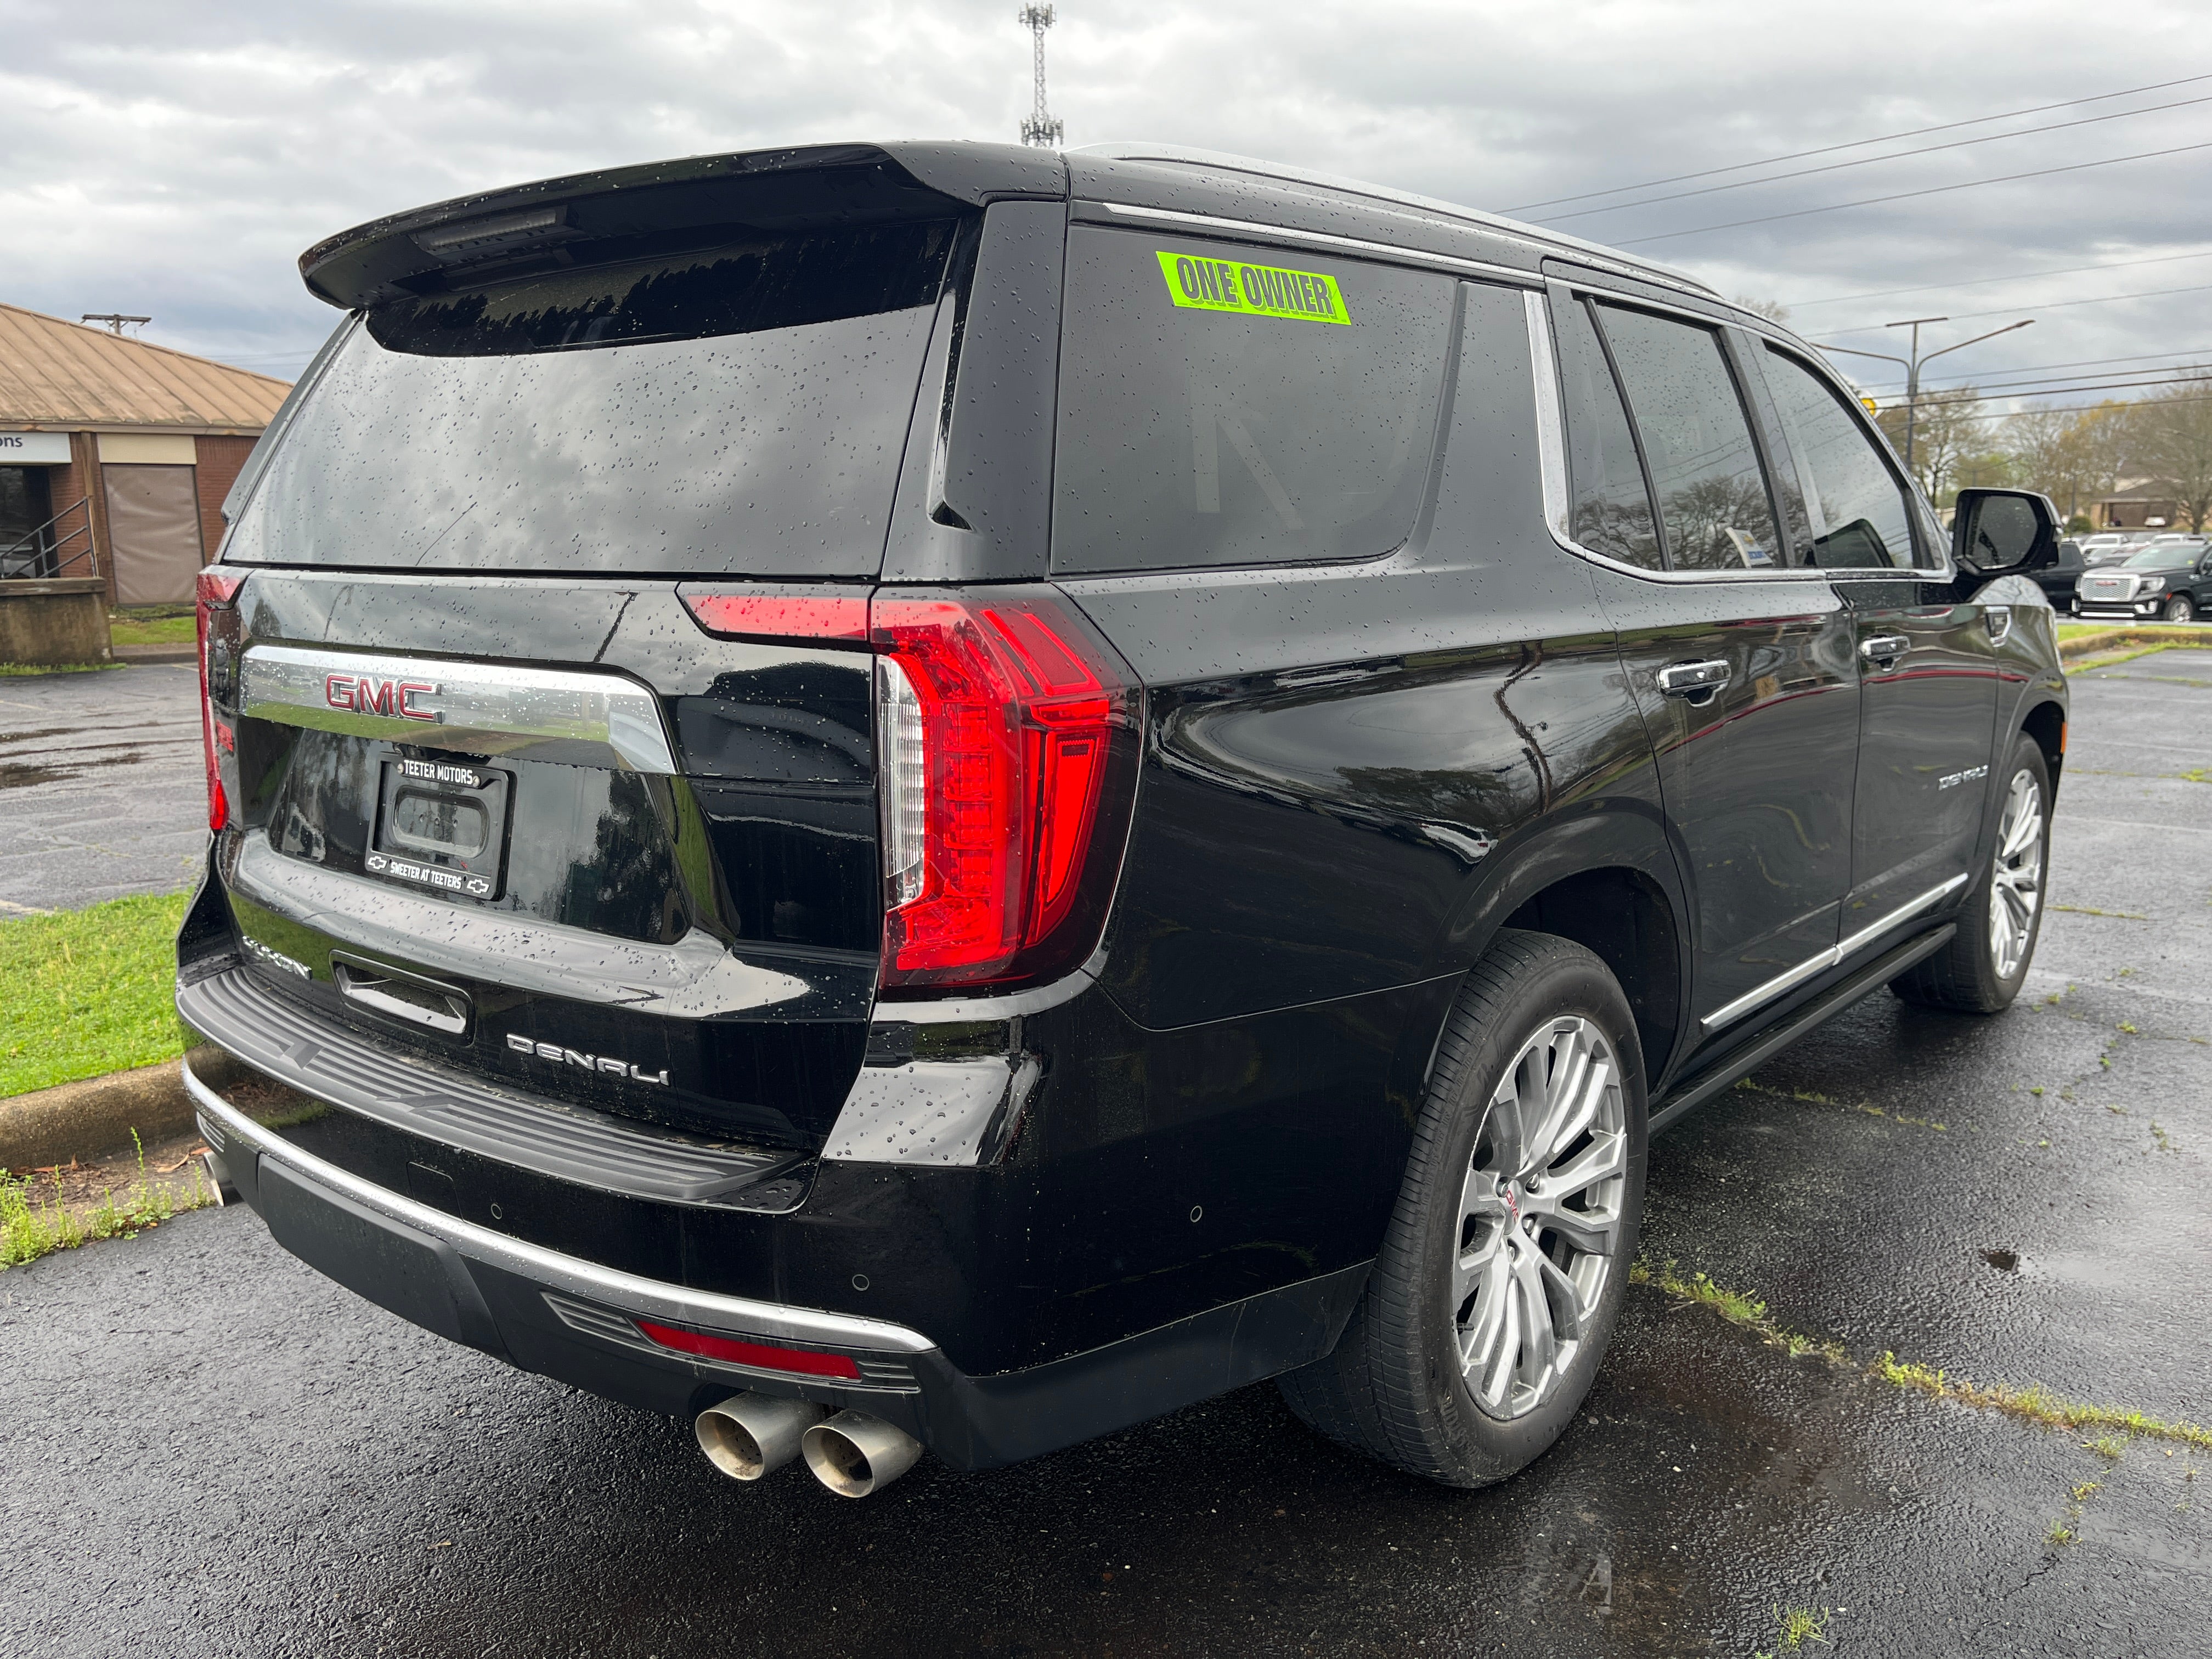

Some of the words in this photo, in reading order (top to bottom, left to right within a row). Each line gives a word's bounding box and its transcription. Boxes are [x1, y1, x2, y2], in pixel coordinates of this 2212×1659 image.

[1176, 257, 1242, 308] ONE
[1240, 266, 1339, 320] OWNER
[325, 673, 442, 724] GMC
[404, 760, 435, 779] TEETER
[437, 765, 473, 785] MOTORS
[390, 861, 420, 879] SWEETER
[420, 868, 431, 882] AT
[431, 871, 462, 889] TEETERS
[506, 1033, 670, 1086] DENALI
